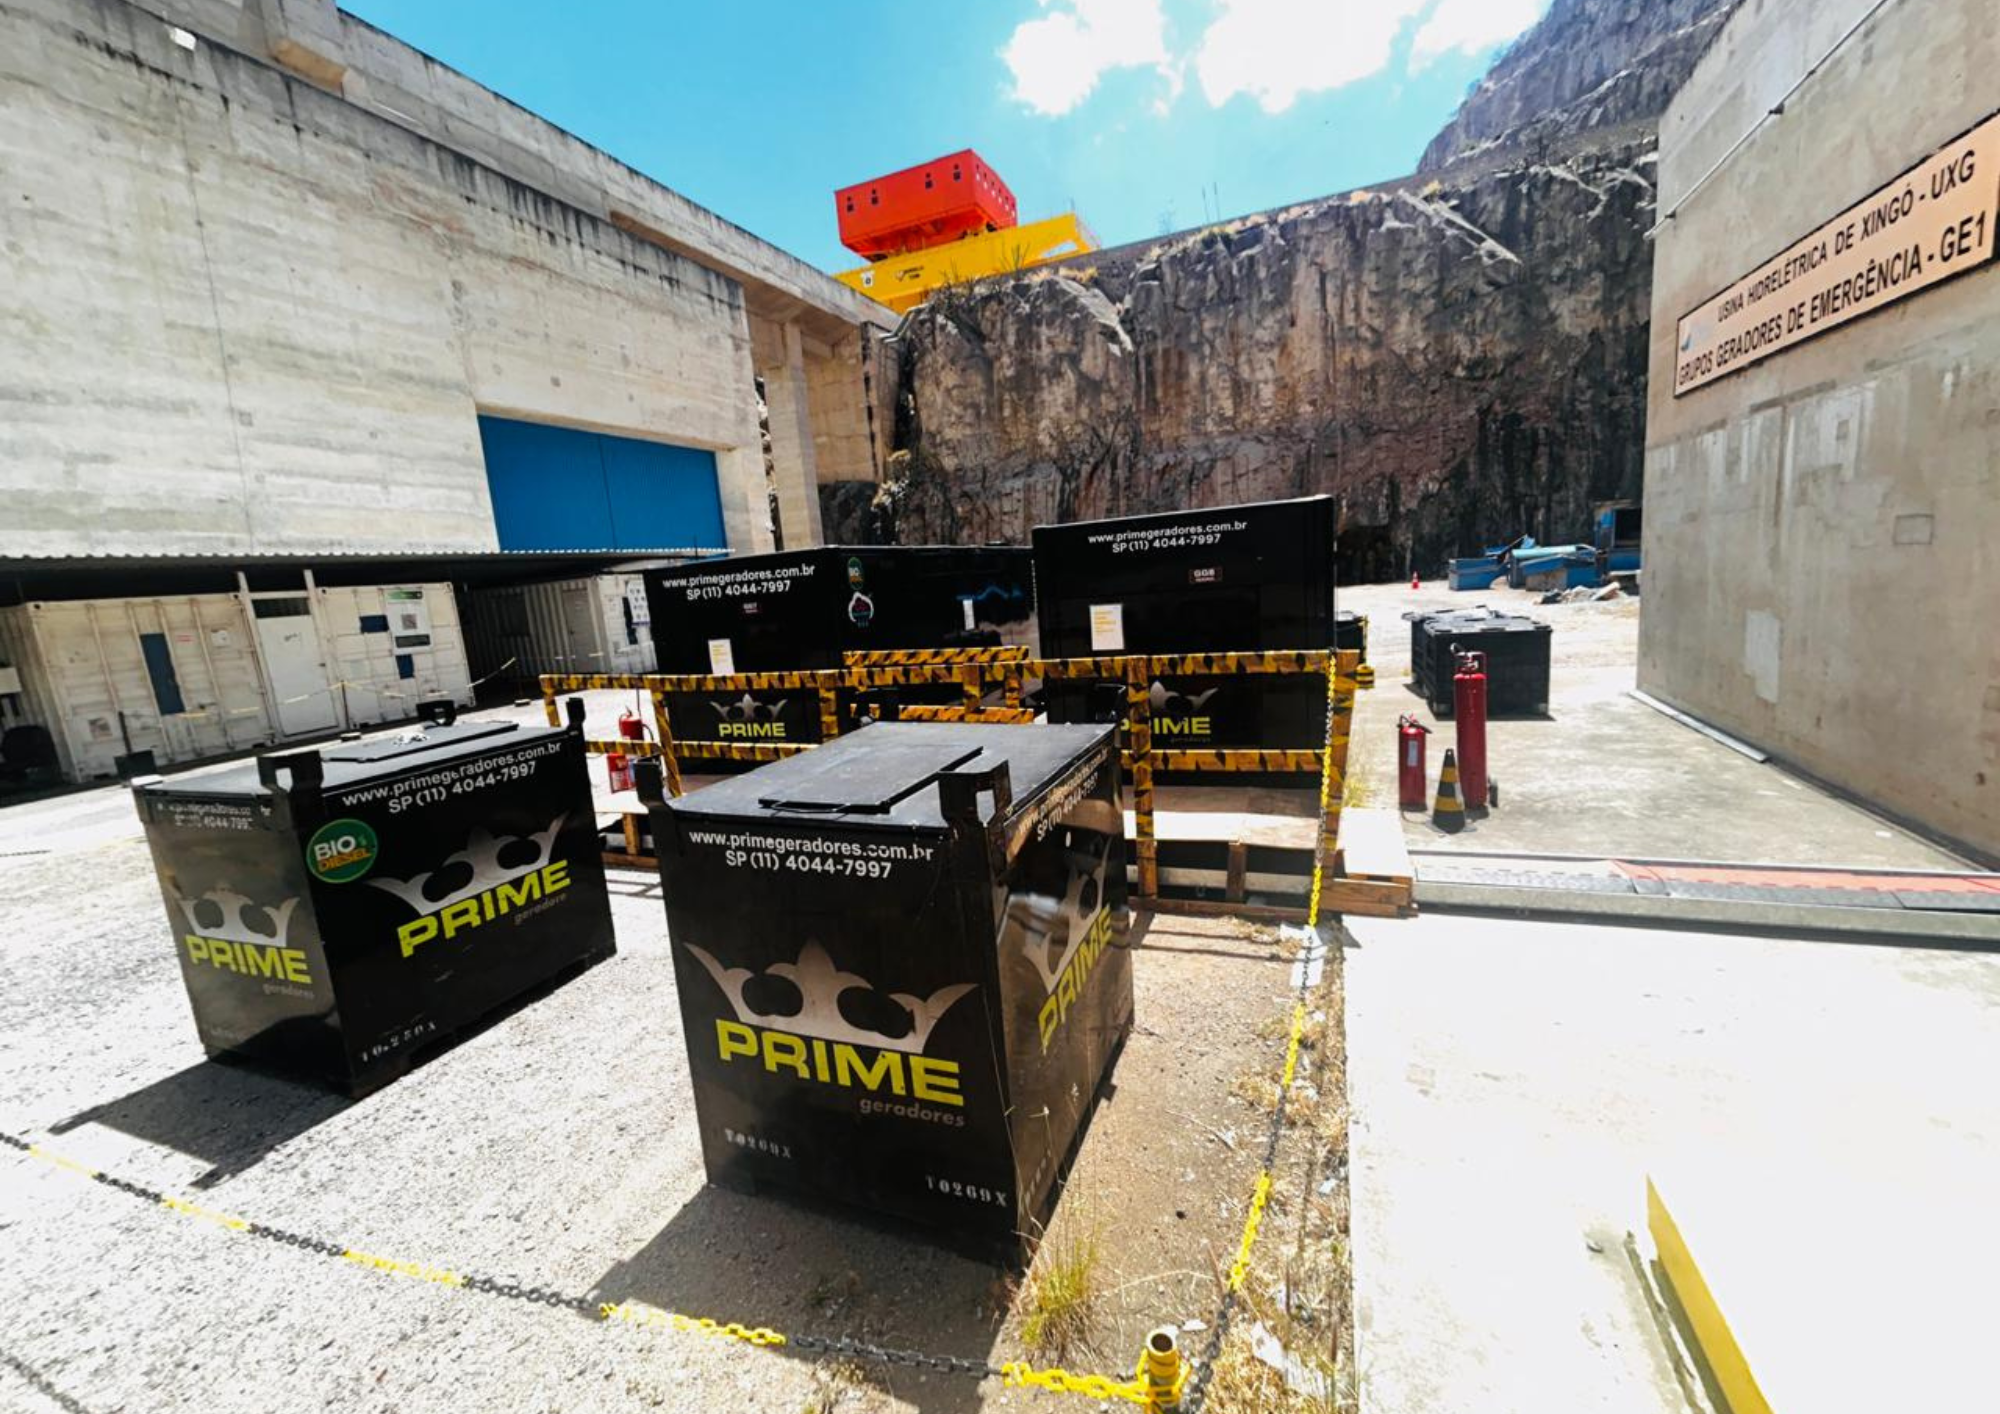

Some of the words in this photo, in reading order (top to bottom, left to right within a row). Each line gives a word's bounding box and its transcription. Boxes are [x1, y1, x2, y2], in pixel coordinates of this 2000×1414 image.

[1718, 293, 1744, 322] USINA
[1748, 241, 1827, 302] HIDRELÉTRICA
[1835, 223, 1855, 256] DE
[1860, 183, 1914, 241] XINGÓ
[1931, 150, 1975, 199] UXG
[1679, 350, 1713, 386] GRUPOS
[1716, 314, 1782, 368] GERADORES
[1787, 301, 1806, 333] DE
[1810, 244, 1922, 323] EMERGÊNCIA
[1941, 210, 1986, 262] GE1
[1088, 521, 1247, 543] www.primegeradores.com.br
[1112, 543, 1127, 553] SP
[1129, 540, 1149, 552] (11)
[1153, 533, 1221, 548] 4044-7997
[662, 563, 815, 588] www.primegeradores.com.br
[686, 588, 700, 600] SP
[702, 587, 722, 599] (11)
[725, 580, 791, 596] 4044-7997
[719, 722, 786, 737] PRIME
[388, 796, 414, 814] SP
[416, 786, 447, 806] (11)
[452, 760, 536, 795] 4044-7997
[314, 835, 356, 860] BIO
[689, 831, 934, 861] www.primegeradores.com.br
[725, 851, 747, 867] SP
[750, 852, 780, 870] (11)
[785, 855, 892, 878] 4044-7997
[397, 859, 571, 958] PRIME
[185, 934, 312, 984] PRIME
[1038, 902, 1112, 1056] PRIME
[716, 1019, 964, 1106] PRIME
[860, 1098, 966, 1127] geradores
